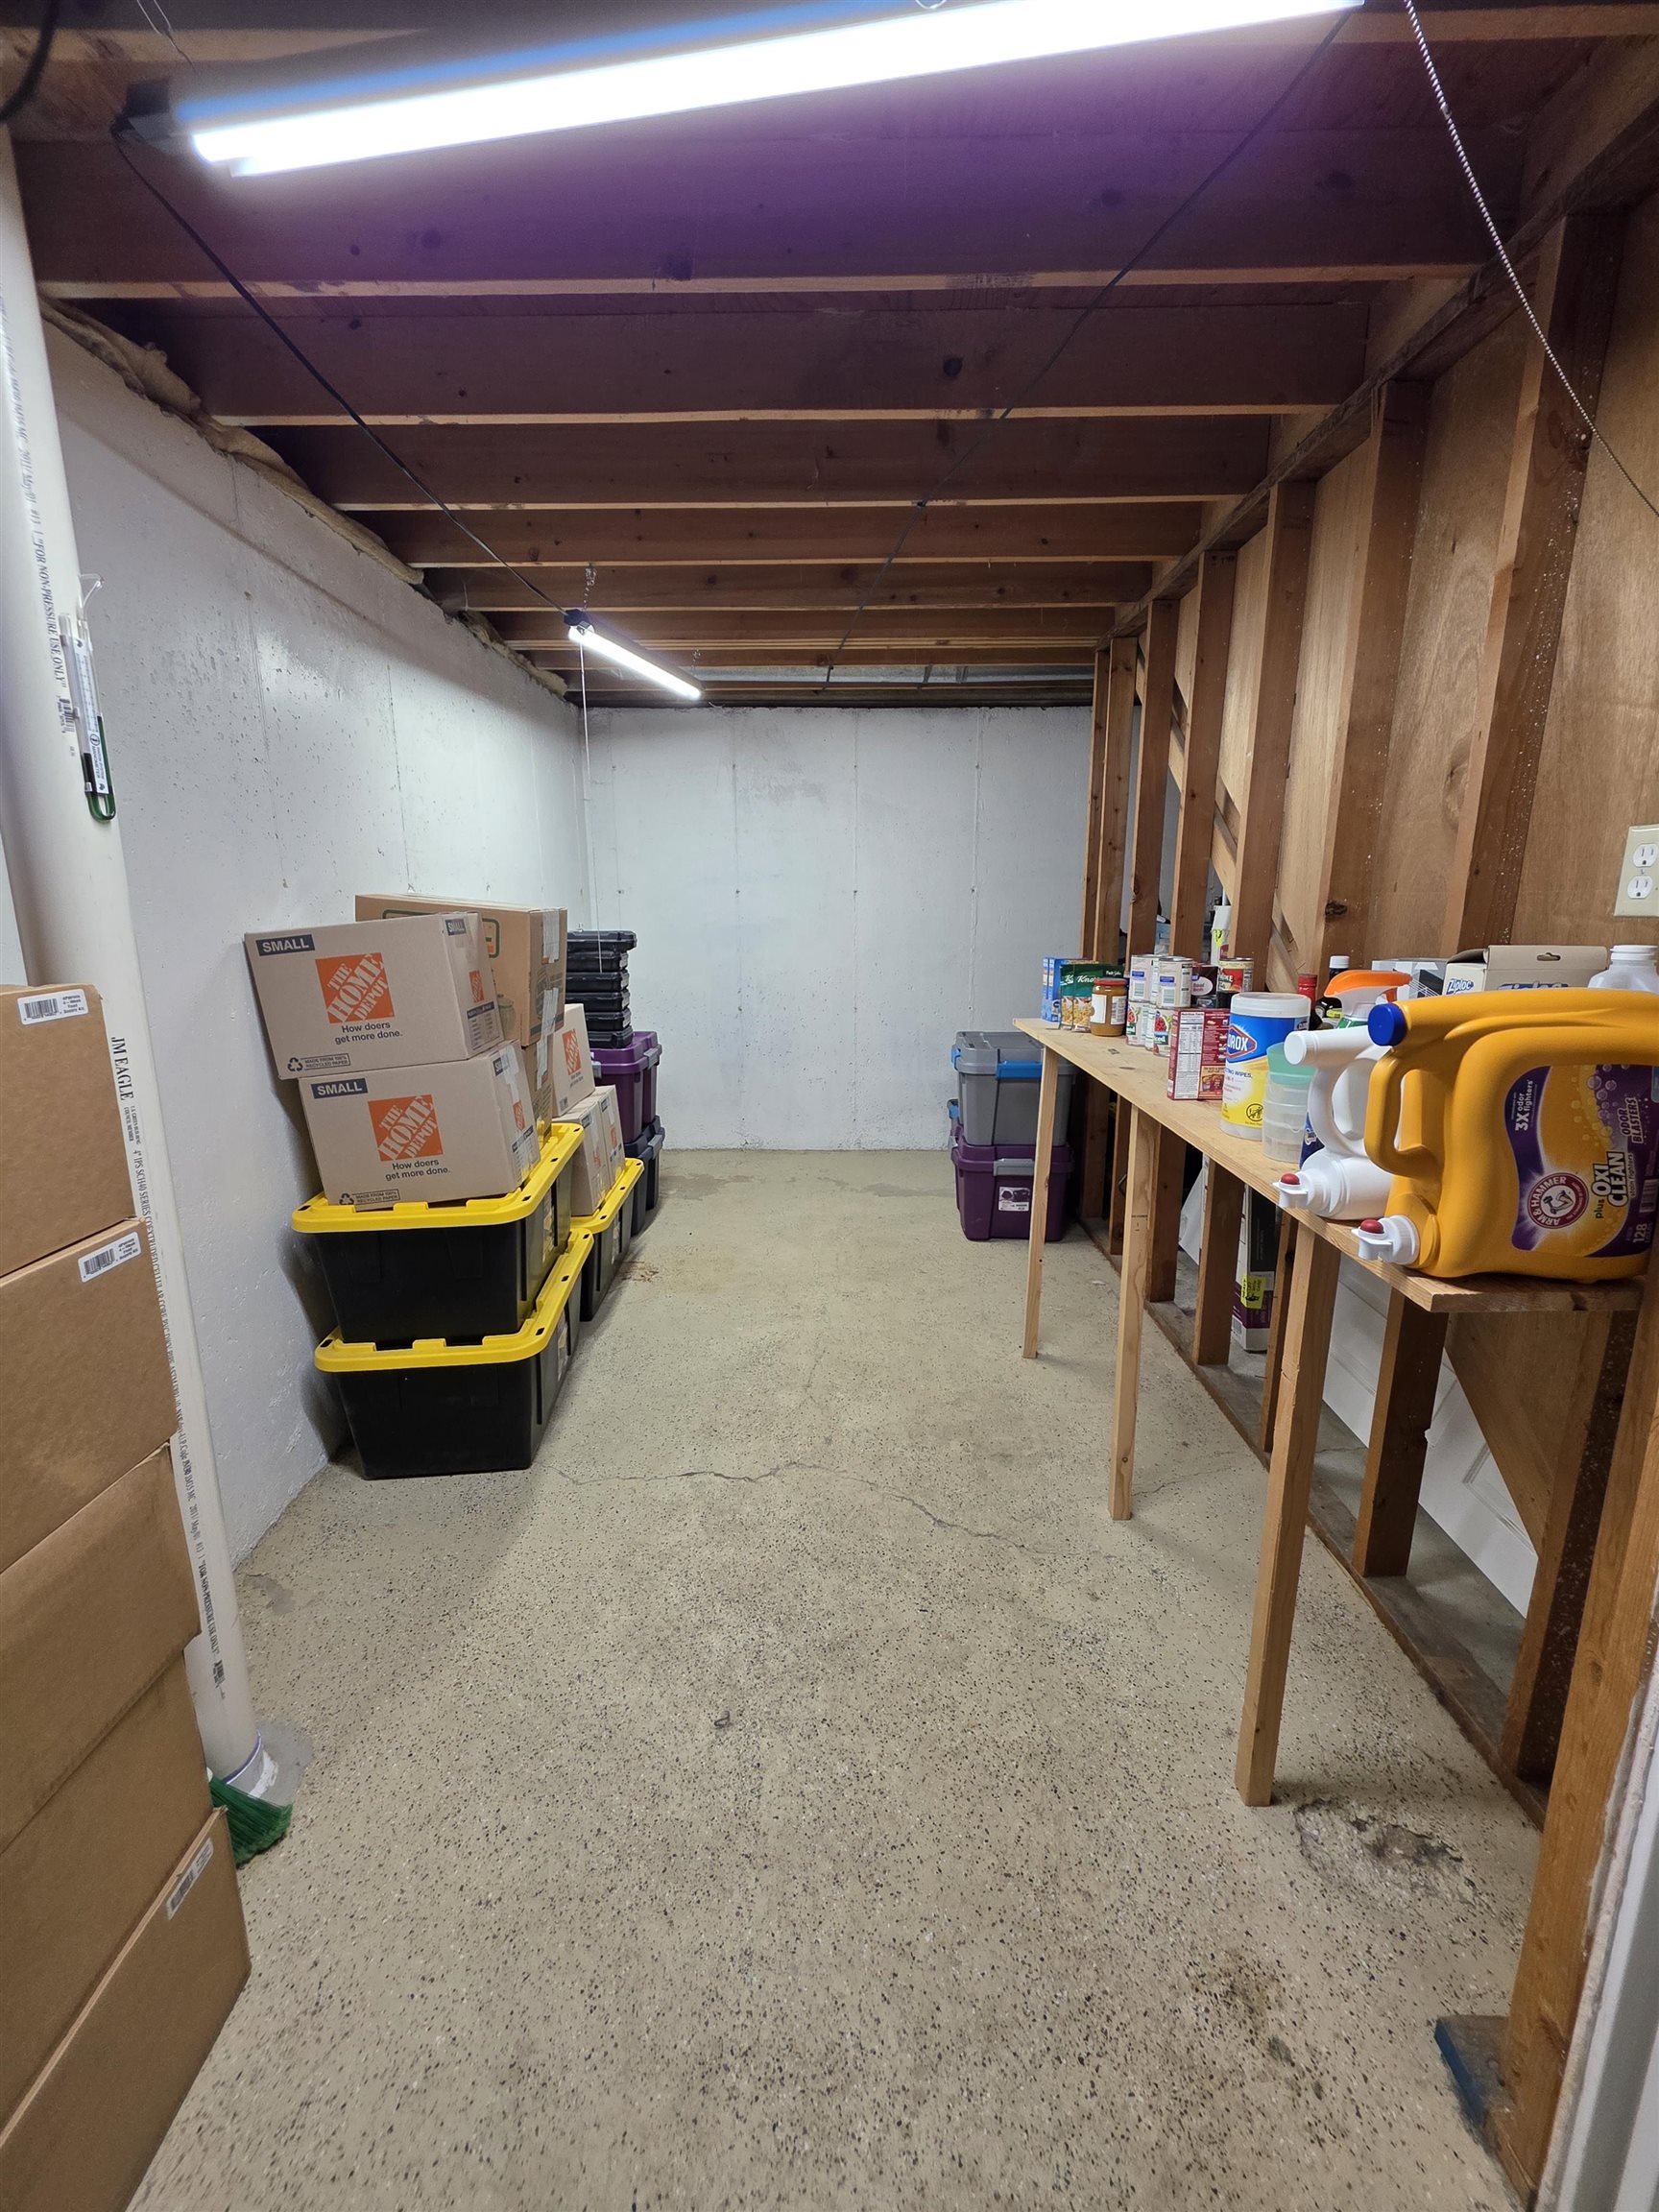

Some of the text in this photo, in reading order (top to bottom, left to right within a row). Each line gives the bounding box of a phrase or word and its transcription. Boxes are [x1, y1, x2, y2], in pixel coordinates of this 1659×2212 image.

[38, 565, 60, 637] NON-PRESSURE
[49, 637, 60, 656] USE
[262, 939, 309, 953] SMALL
[325, 952, 385, 1023] HOME
[326, 963, 352, 992] THE
[1448, 978, 1473, 994] Ziploc
[353, 976, 389, 1021] DEPOT
[335, 1029, 403, 1046] get more done.
[342, 1022, 391, 1034] How doers
[110, 1037, 134, 1101] JM EAGLE
[317, 1081, 363, 1095] SMALL
[1517, 1093, 1526, 1112] odor
[377, 1094, 434, 1161] HOME
[378, 1104, 403, 1131] THE
[1515, 1113, 1530, 1131] 3X
[1618, 1108, 1631, 1136] ODOR
[1624, 1097, 1644, 1143] BLASTERS
[403, 1118, 438, 1158] DEPOT
[385, 1166, 451, 1182] get more done.
[414, 1159, 440, 1168] doers
[134, 1158, 144, 1169] IPS
[139, 1191, 151, 1216] SERIES
[1592, 1163, 1613, 1196] OXI
[1607, 1151, 1628, 1207] CLEAN
[1530, 1176, 1567, 1226] ARM & HAMMER
[1594, 1199, 1605, 1219] plus
[1633, 1222, 1647, 1243] 128
[200, 1578, 216, 1623] NON-PRESSURE
[207, 1623, 217, 1635] USE
